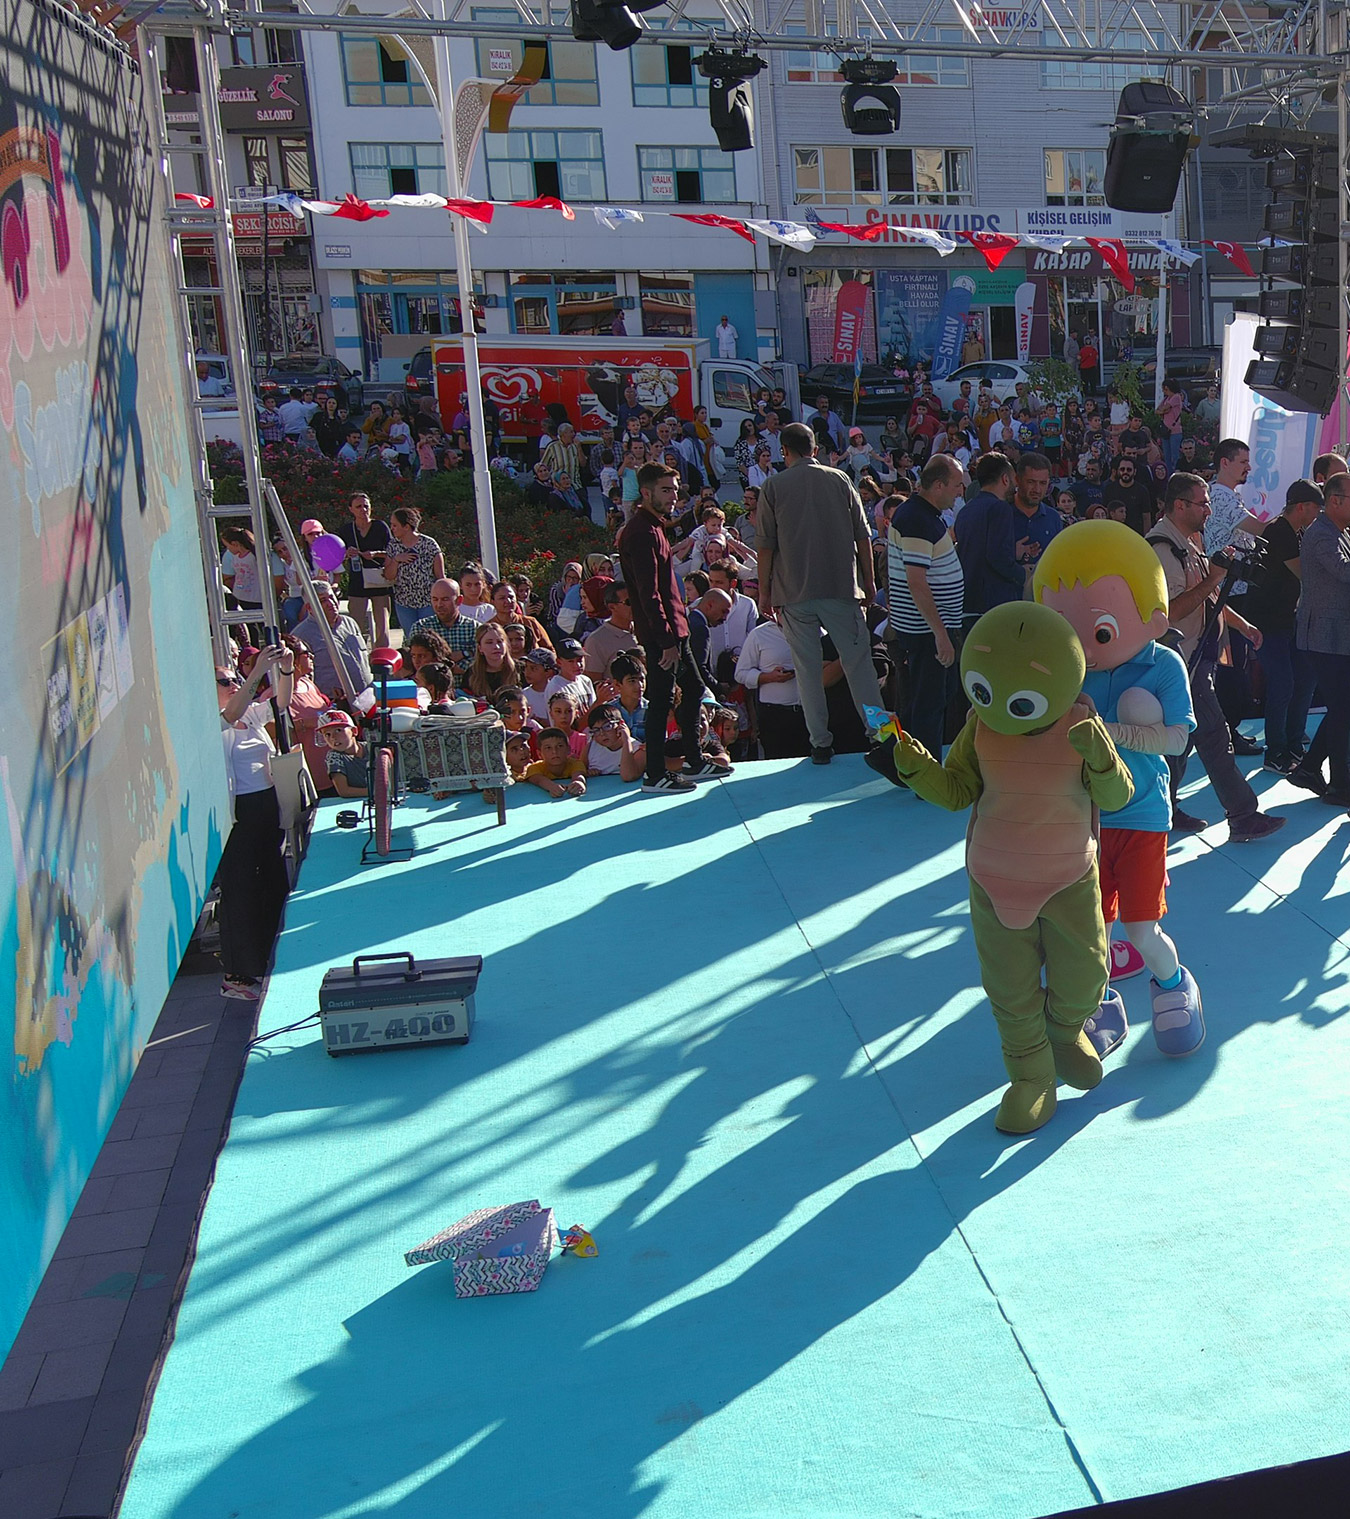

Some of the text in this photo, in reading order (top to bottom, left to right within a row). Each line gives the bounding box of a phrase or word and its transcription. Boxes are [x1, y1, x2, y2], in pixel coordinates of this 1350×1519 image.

[713, 78, 724, 89] 3
[257, 109, 294, 121] SALONU
[1027, 210, 1112, 227] KİŞİSEL GELİŞİM
[1034, 251, 1092, 271] KASAP
[889, 274, 938, 283] USTA KAPTAN
[910, 292, 939, 300] HAVADA
[920, 299, 939, 308] OLUR
[838, 311, 857, 351] SINAV
[939, 315, 960, 356] SINAV
[1019, 313, 1030, 352] SINAV
[325, 1013, 456, 1046] HZ-400
